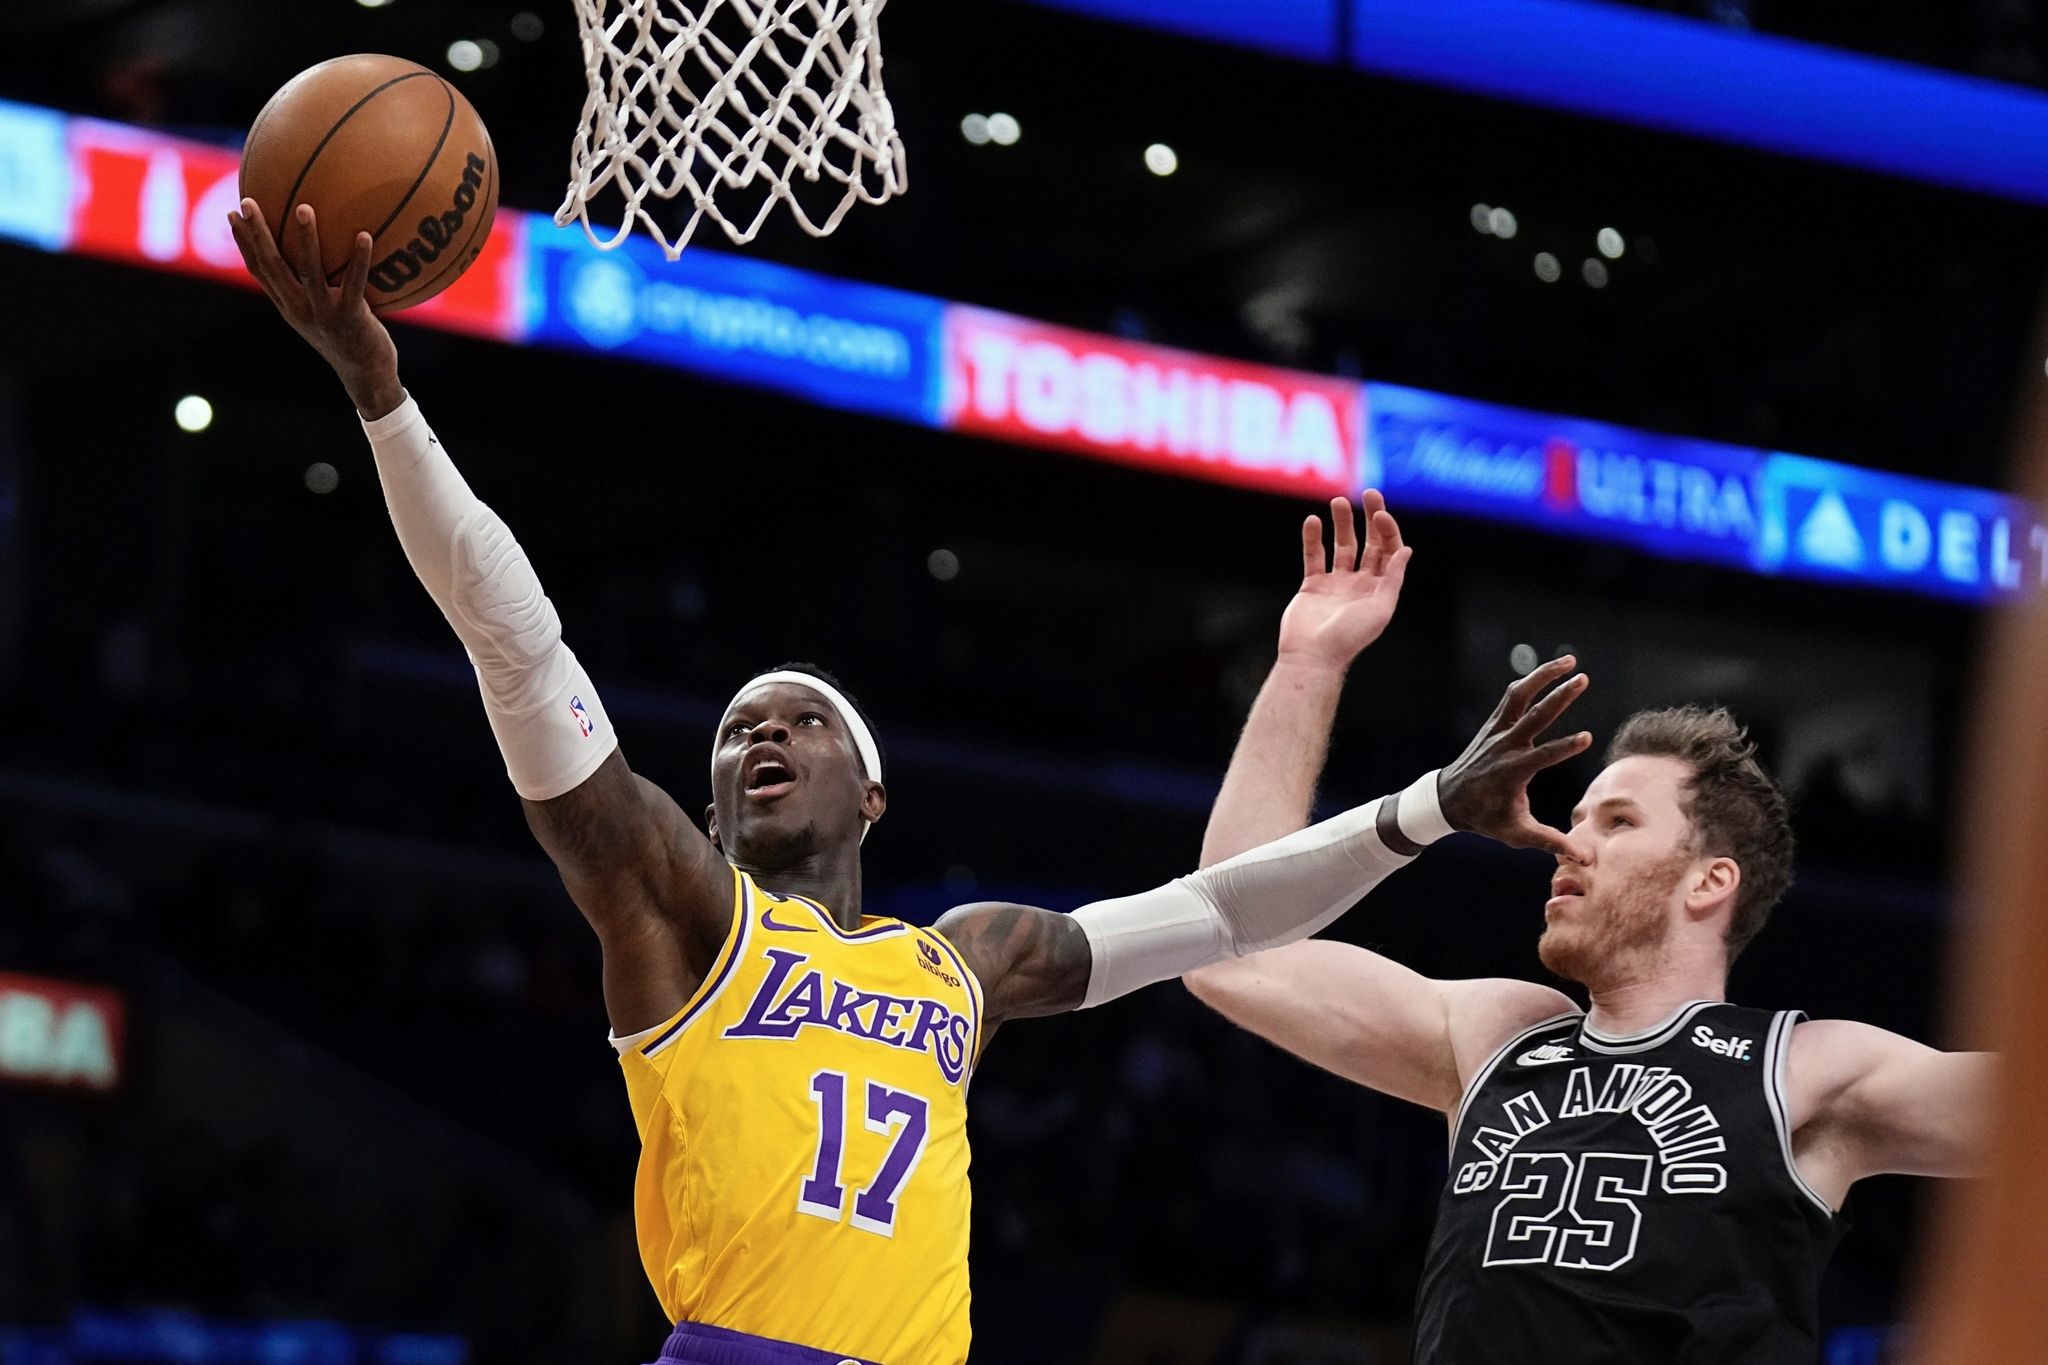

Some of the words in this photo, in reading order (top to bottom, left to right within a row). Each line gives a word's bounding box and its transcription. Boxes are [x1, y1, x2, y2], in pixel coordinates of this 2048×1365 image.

[367, 151, 485, 292] Wilson
[959, 334, 1344, 480] TOSHIBA
[721, 947, 971, 1086] LAKERS
[917, 954, 960, 987] bibigo
[1529, 1044, 1574, 1061] NIKE
[796, 1067, 930, 1238] 17
[1454, 1091, 1551, 1194] SAN
[1559, 1064, 1727, 1194] ANTONIO
[1482, 1152, 1653, 1271] 25
